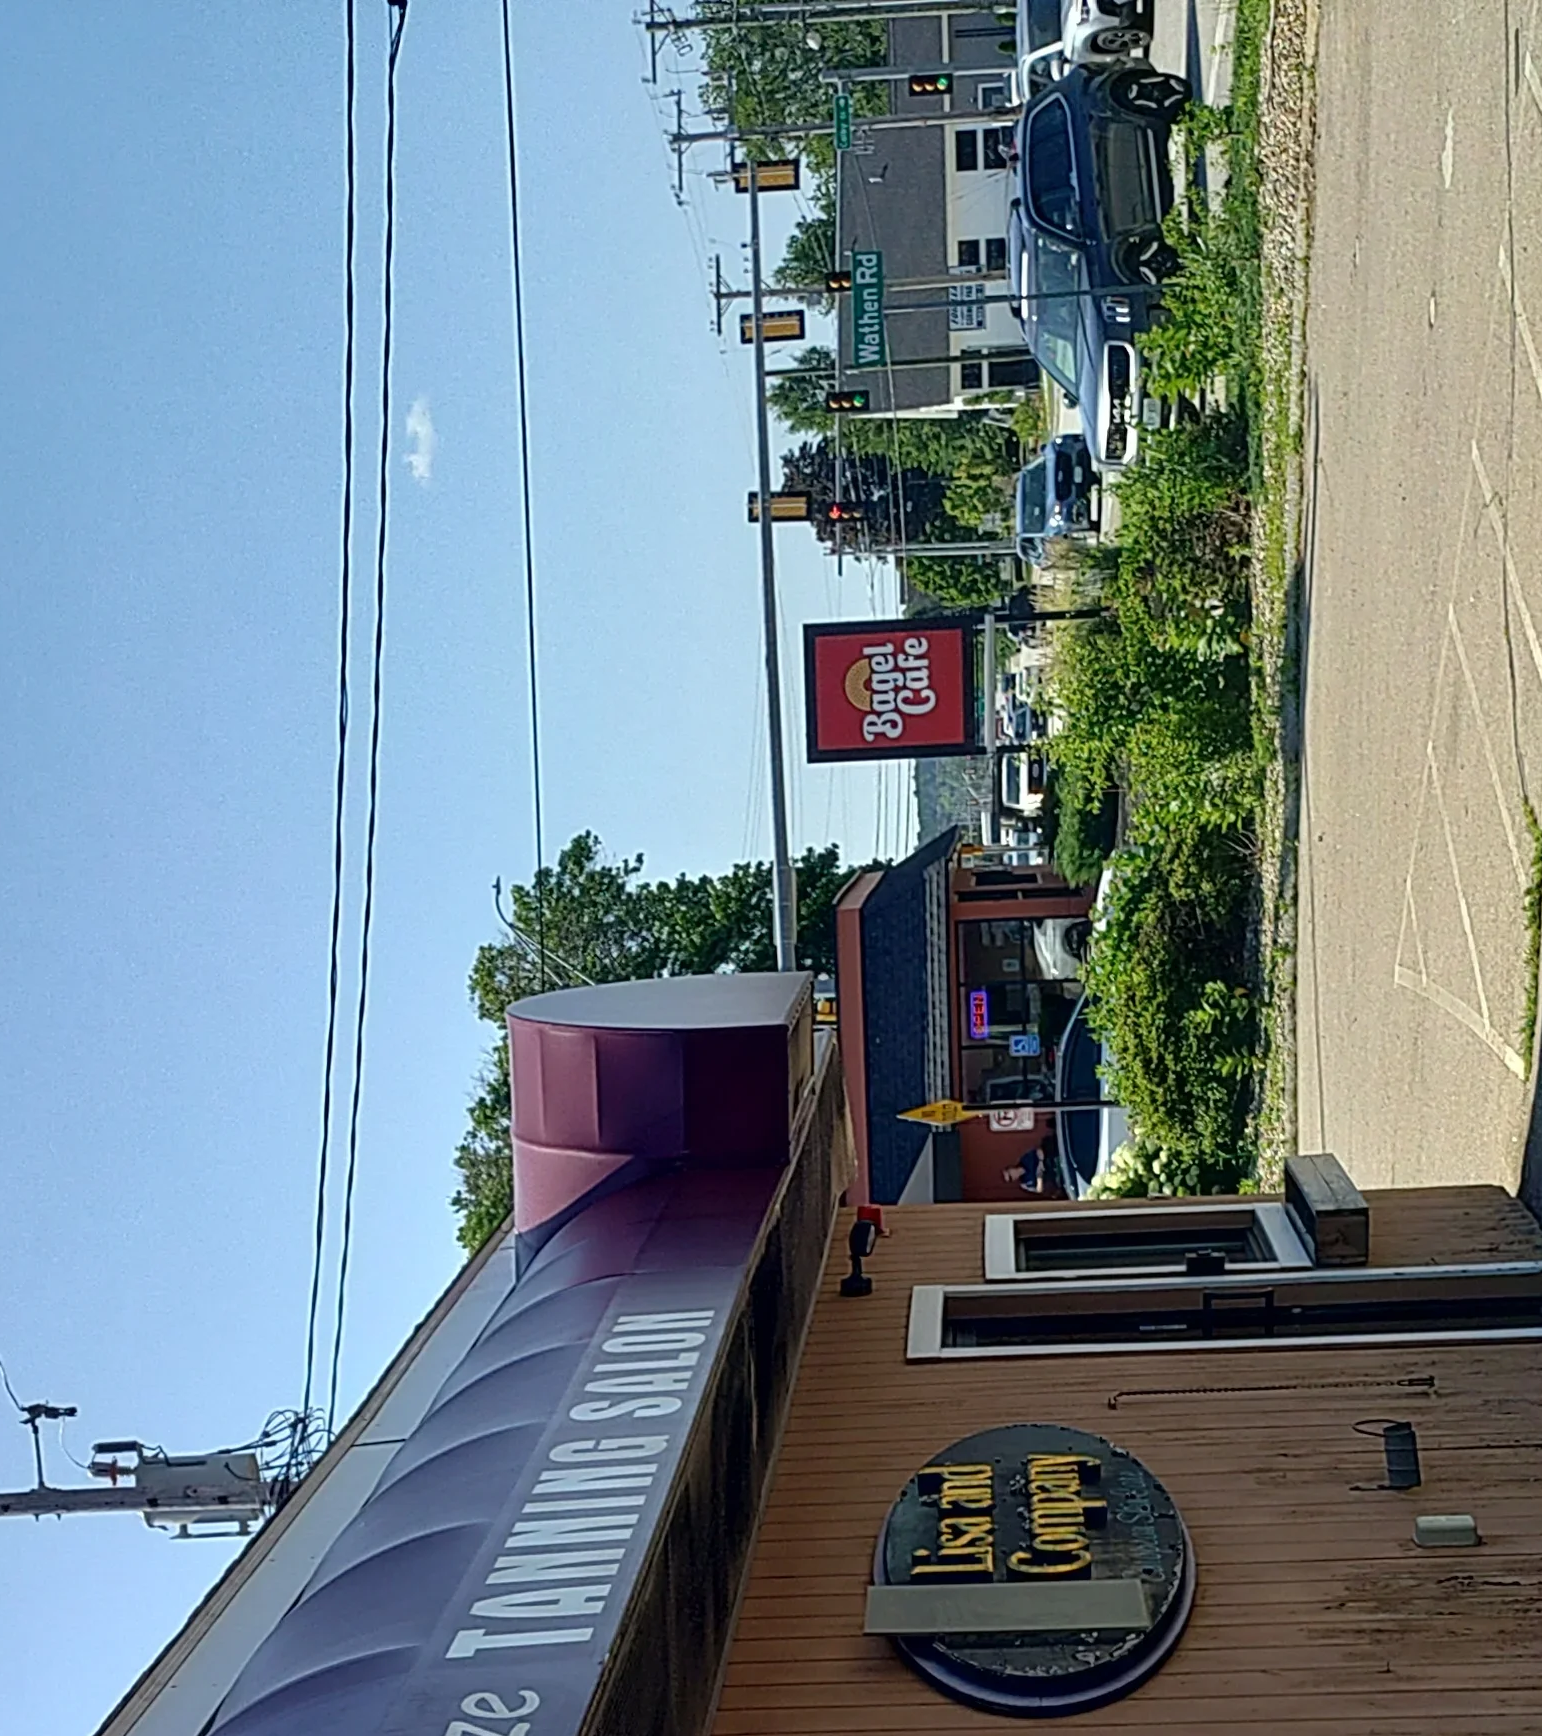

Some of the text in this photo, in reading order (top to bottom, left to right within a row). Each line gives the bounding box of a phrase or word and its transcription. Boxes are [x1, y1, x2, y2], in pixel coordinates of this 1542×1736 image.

[855, 254, 880, 364] Wathen Rd
[862, 643, 904, 742] Bagel
[896, 637, 936, 715] Cafe
[973, 995, 985, 1034] OPEN
[445, 1435, 670, 1659] TANNING
[568, 1309, 715, 1421] SALON
[910, 1462, 995, 1574] Lisa and
[1006, 1453, 1107, 1574] Company
